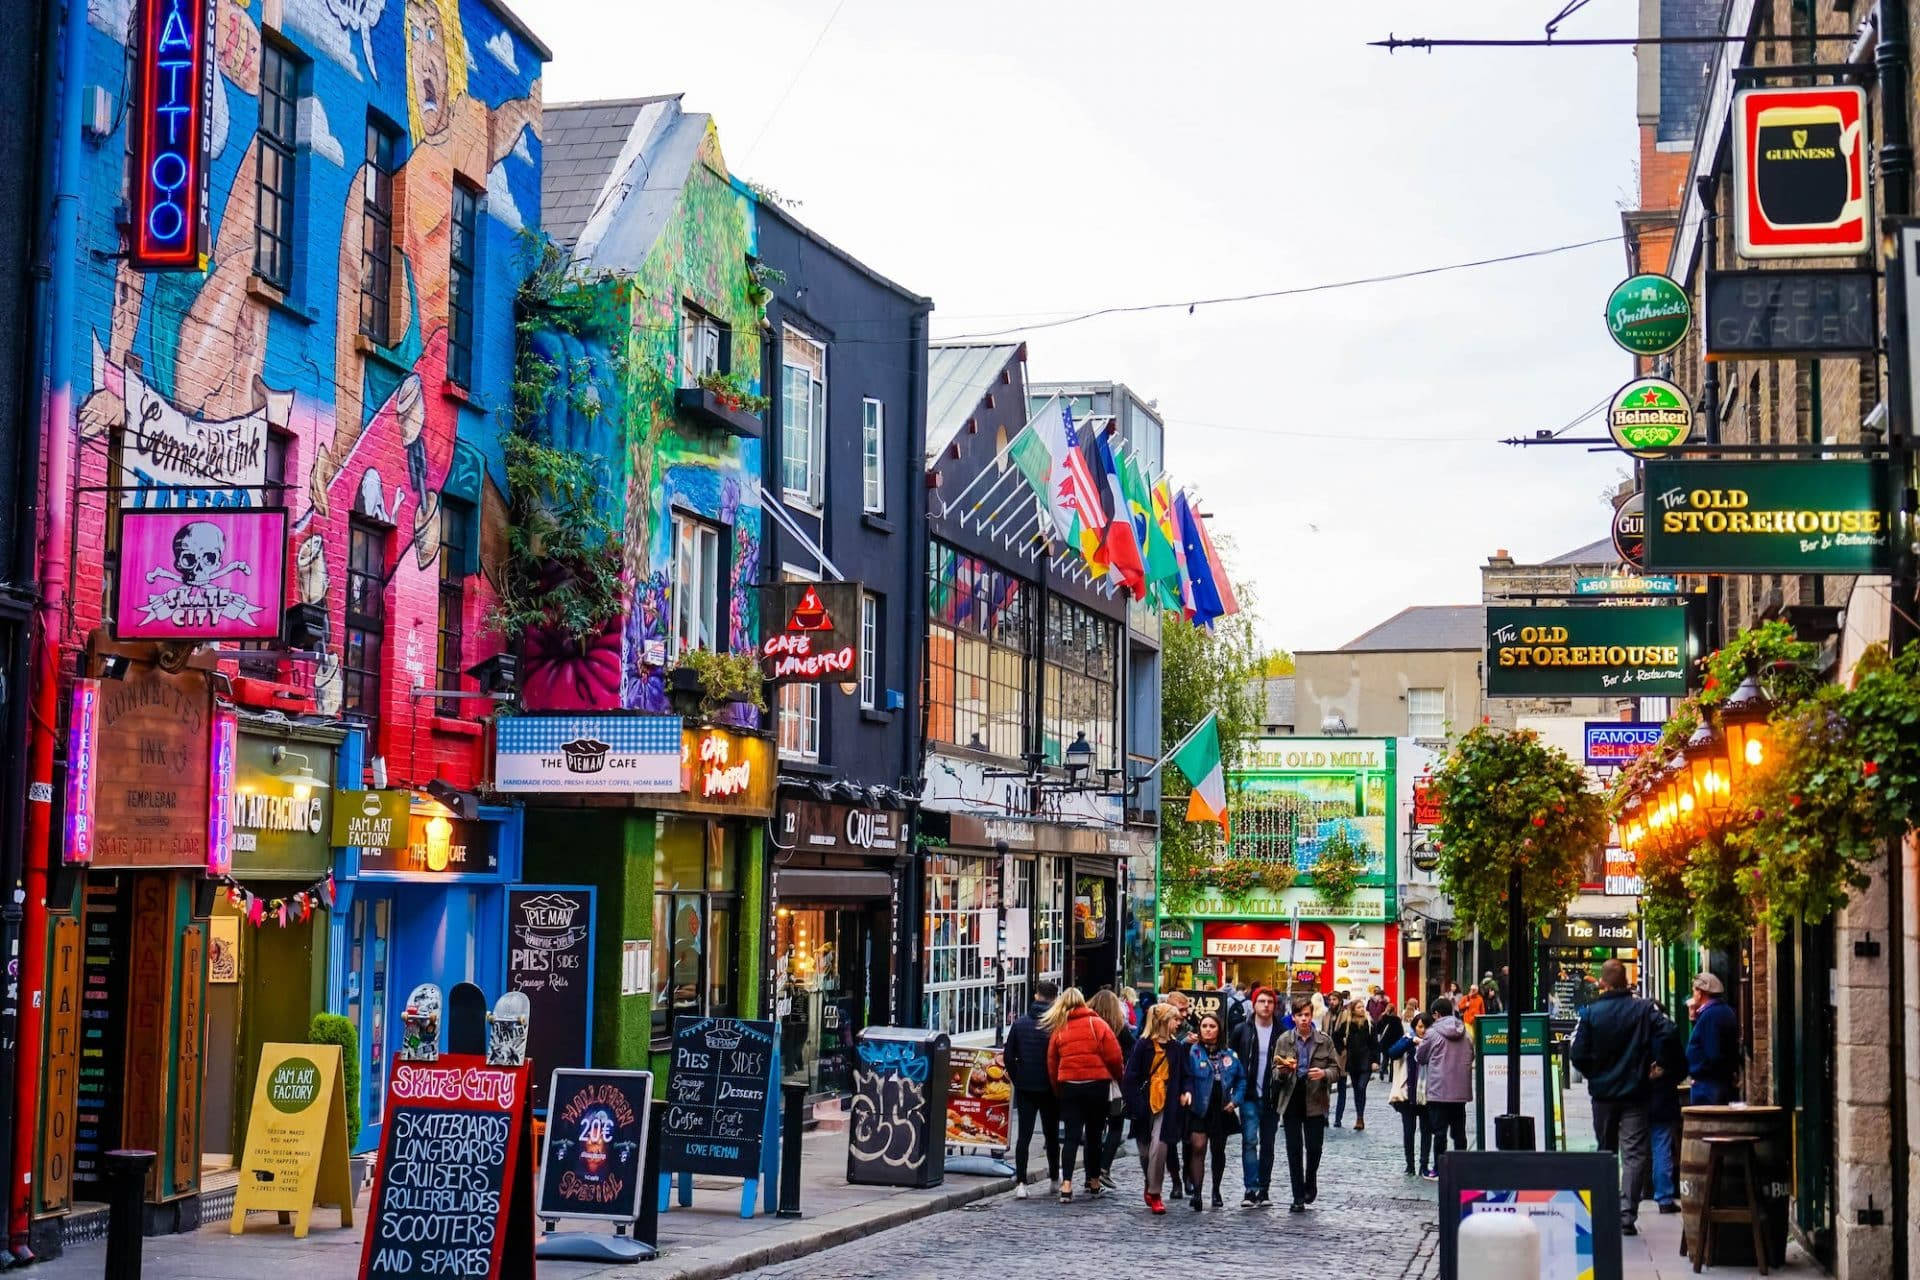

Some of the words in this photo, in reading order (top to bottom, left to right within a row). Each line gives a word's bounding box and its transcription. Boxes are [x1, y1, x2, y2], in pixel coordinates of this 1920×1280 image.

[150, 0, 192, 239] ATTOO
[1765, 147, 1836, 161] GUINNESS
[1612, 301, 1688, 332] Smithwick's
[1715, 315, 1868, 344] GARDEN
[1614, 409, 1687, 424] Heineken
[228, 426, 259, 478] Ink
[1657, 487, 1686, 510] The
[1689, 489, 1749, 509] OLD
[1662, 511, 1881, 533] STOREHOUSE
[1799, 538, 1820, 552] Bar
[1835, 532, 1887, 546] Restaurant
[1581, 580, 1608, 593] LEO
[1611, 579, 1673, 591] BURDOCK
[168, 588, 230, 609] SKATE
[171, 608, 224, 628] CITY
[1492, 624, 1517, 643] The
[1520, 626, 1569, 643] OLD
[1498, 646, 1679, 666] STOREHOUSE
[1602, 675, 1620, 687] Bar
[1623, 670, 1633, 683] &
[1636, 668, 1684, 682] Restaurant
[1590, 731, 1657, 744] FAMOUS
[139, 738, 166, 765] INK
[1286, 752, 1325, 767] OLD
[1330, 752, 1378, 767] MILL
[1590, 744, 1614, 756] FISH
[541, 758, 563, 769] THE
[567, 754, 604, 771] PIEMAN
[609, 758, 637, 769] CAFE
[217, 721, 233, 864] TATTOO
[248, 794, 268, 829] ART
[268, 797, 310, 832] FACTORY
[785, 812, 796, 833] 12
[348, 817, 370, 832] JAM
[373, 818, 393, 832] ART
[846, 809, 876, 849] CRU
[348, 831, 390, 846] FACTORY
[450, 845, 467, 862] CAFE
[1195, 898, 1235, 915] OLD
[1239, 898, 1286, 915] MILL
[1565, 923, 1594, 938] The
[1598, 924, 1633, 938] Irish
[1215, 943, 1257, 953] TEMPLE
[1261, 943, 1281, 953] TAK
[511, 949, 550, 971] PIES
[556, 954, 580, 969] SIDES
[549, 973, 569, 992] Rolls
[51, 945, 72, 1182] TATTOO
[182, 948, 200, 1165] PIERCING
[677, 1047, 710, 1069] PIES
[731, 1050, 762, 1075] SIDES
[274, 1069, 294, 1084] JAM
[297, 1070, 314, 1084] ART
[273, 1084, 313, 1100] FACTORY
[393, 1066, 462, 1101] SKATE
[462, 1069, 516, 1109] CITY
[678, 1087, 701, 1105] Rolls
[396, 1112, 511, 1144] SKATEBOARDS
[668, 1106, 704, 1131] Coffee
[715, 1108, 744, 1126] Craft
[578, 1118, 615, 1143] 20€
[719, 1124, 744, 1137] Beer
[394, 1138, 505, 1166] LONGBOARDS
[709, 1145, 739, 1159] PIEMAN
[388, 1161, 490, 1193] CRUISERS
[384, 1186, 501, 1214] ROLLERBLADES
[382, 1211, 496, 1246] SCOOTERS
[372, 1247, 413, 1274] AND
[420, 1247, 492, 1276] SPARES
